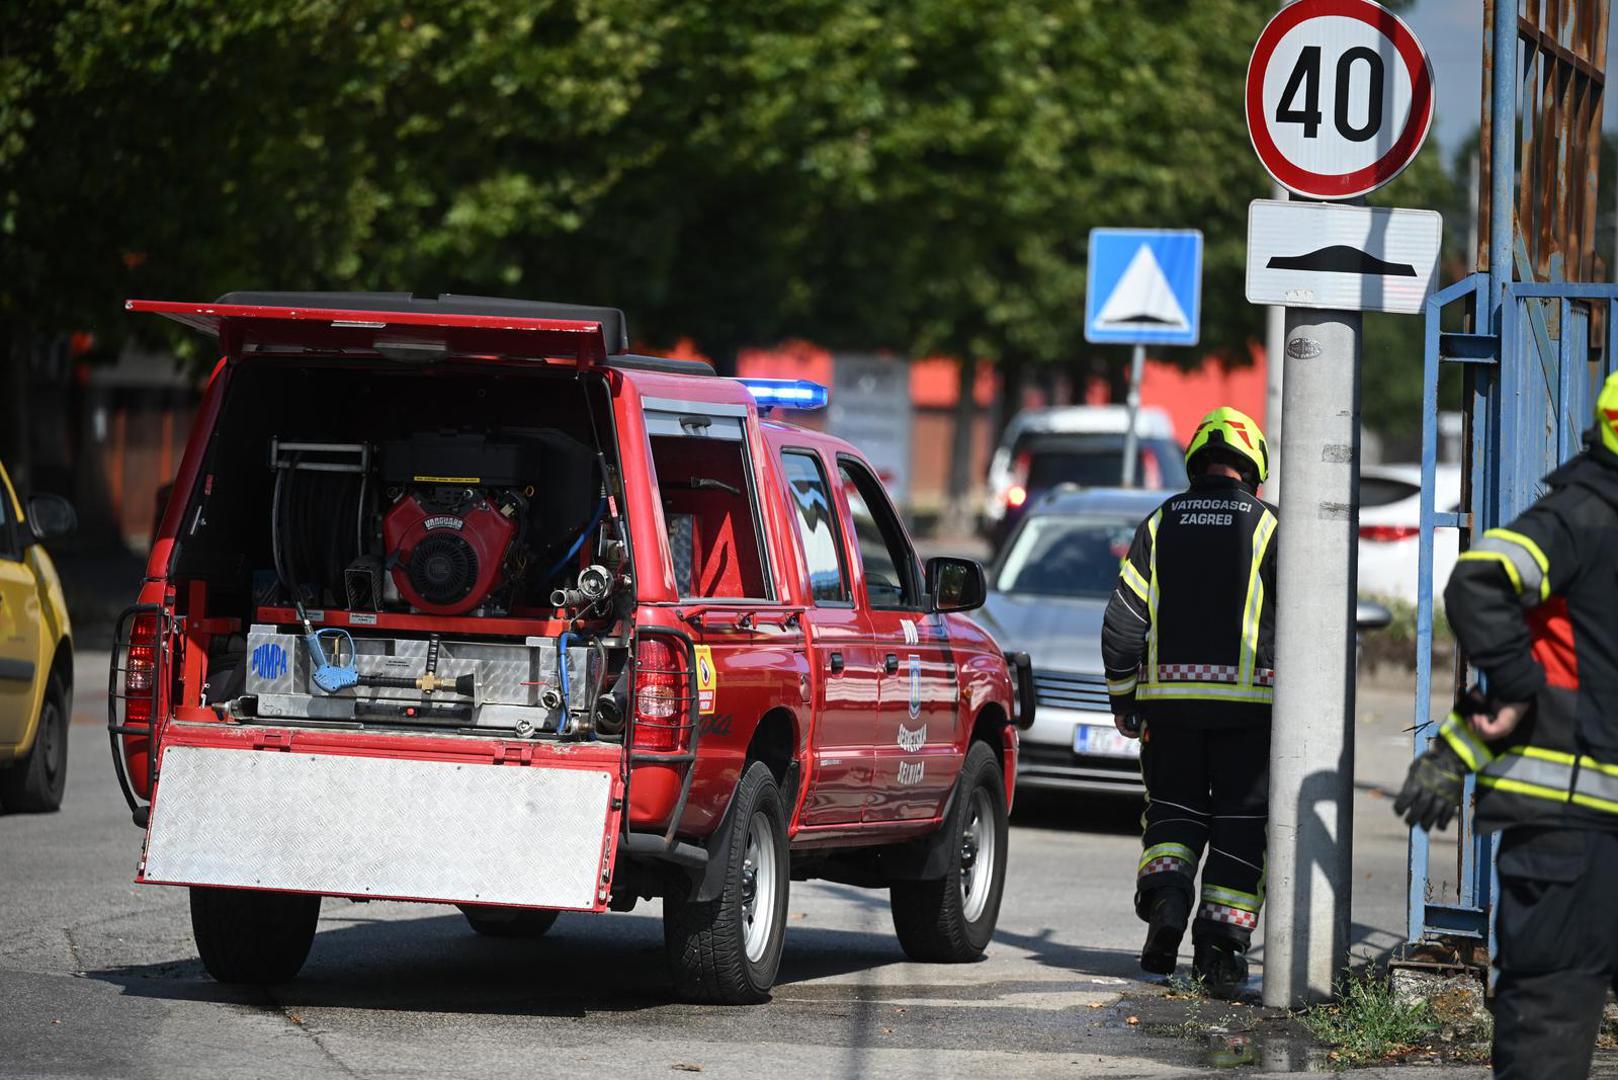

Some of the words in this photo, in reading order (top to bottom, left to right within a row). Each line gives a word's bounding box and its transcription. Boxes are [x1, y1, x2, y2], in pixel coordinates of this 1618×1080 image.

[1276, 46, 1384, 142] 40
[1171, 500, 1252, 513] VATROGASCI
[1179, 514, 1233, 525] ZAGREB
[252, 643, 287, 680] PUMPA
